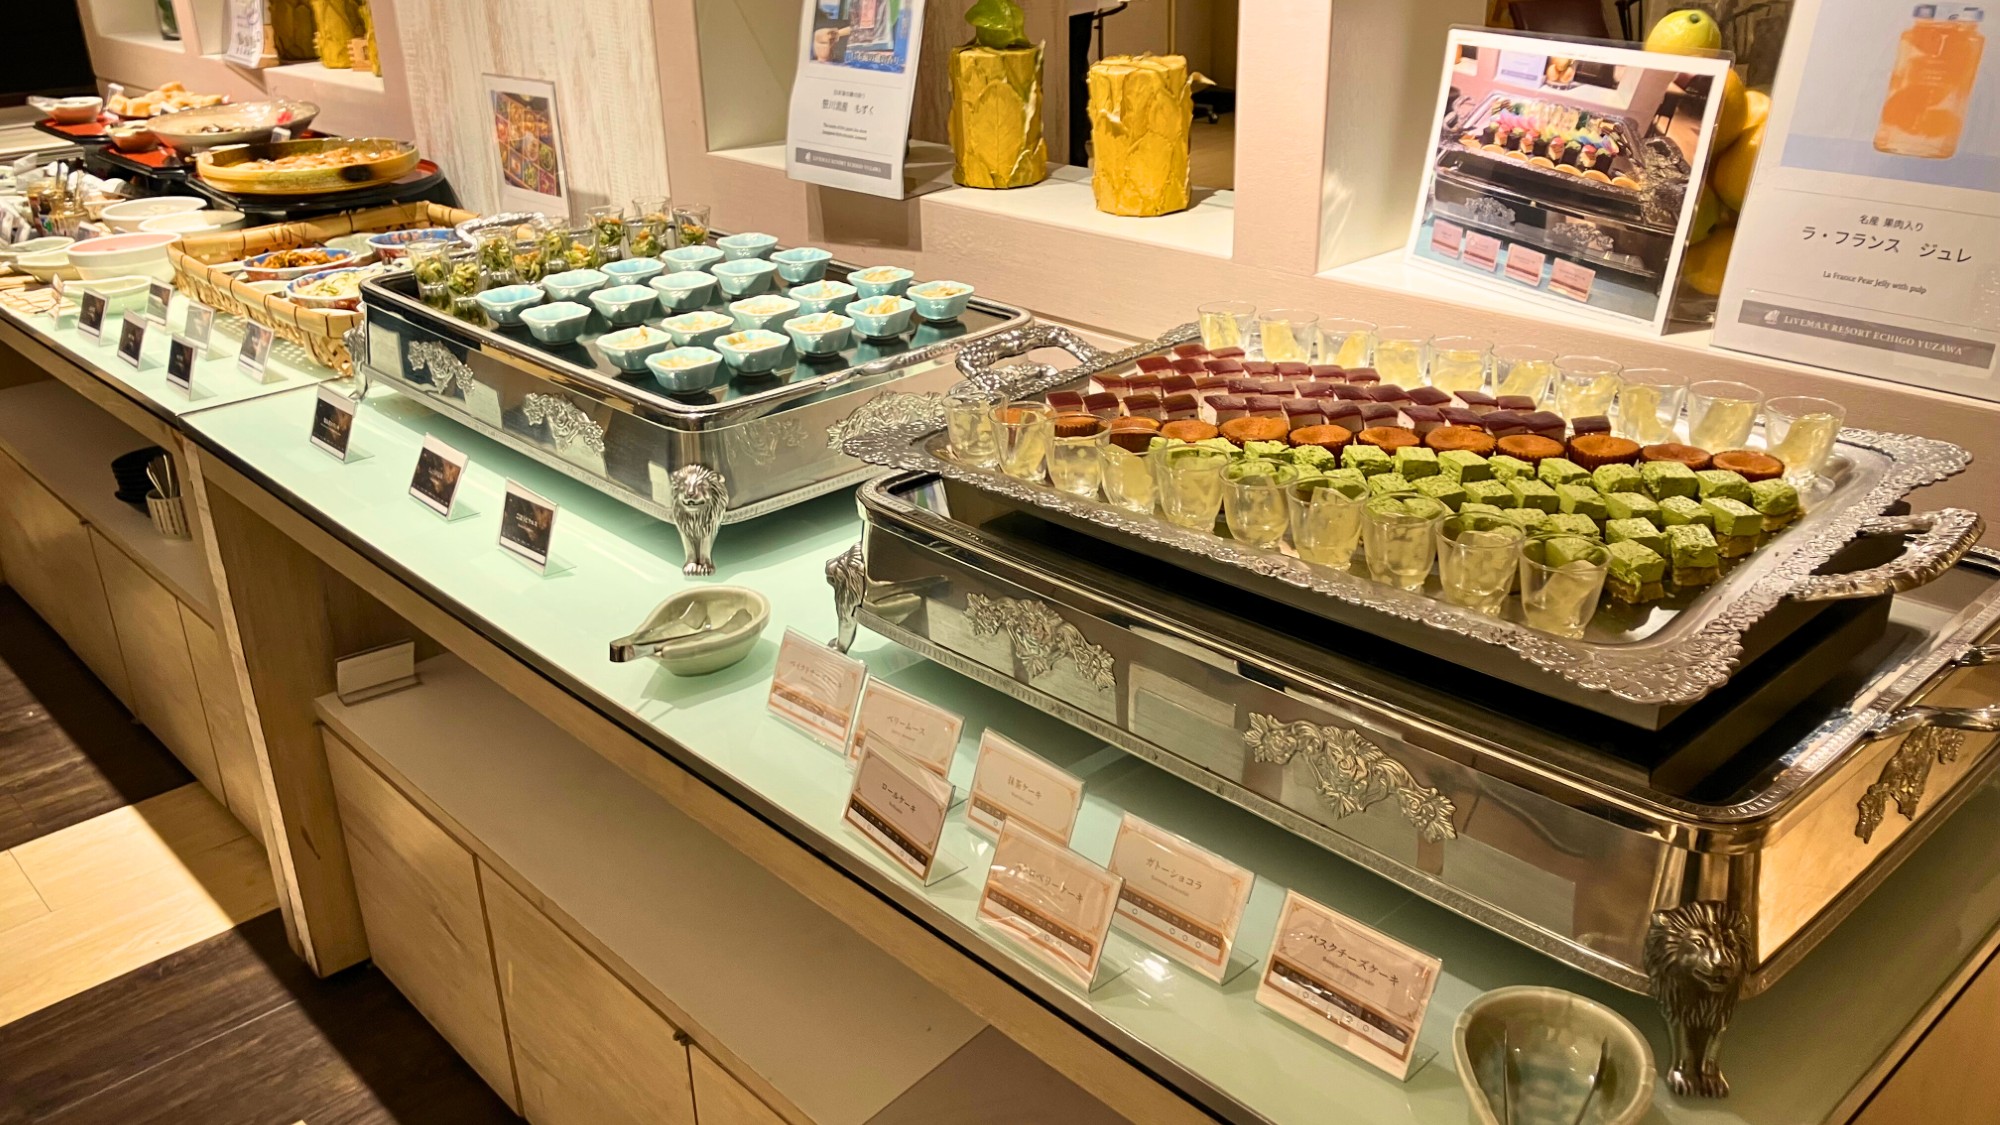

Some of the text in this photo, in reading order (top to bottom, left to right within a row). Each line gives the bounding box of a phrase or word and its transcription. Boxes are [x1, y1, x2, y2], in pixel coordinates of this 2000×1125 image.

[1860, 214, 1924, 232] 名産 果肉入り
[1802, 226, 1973, 263] ラ・フランス ジュレ
[1823, 270, 1927, 295] La France Pear Jelly with pulp
[1831, 322, 1873, 339] RESORT
[1872, 329, 1915, 347] ECHIGO
[1917, 338, 1963, 356] YUZAWA
[881, 782, 917, 813] ロールケーキ
[1145, 857, 1202, 890] ガトーショコラ
[1307, 933, 1400, 988] バスクチーズケーキ
